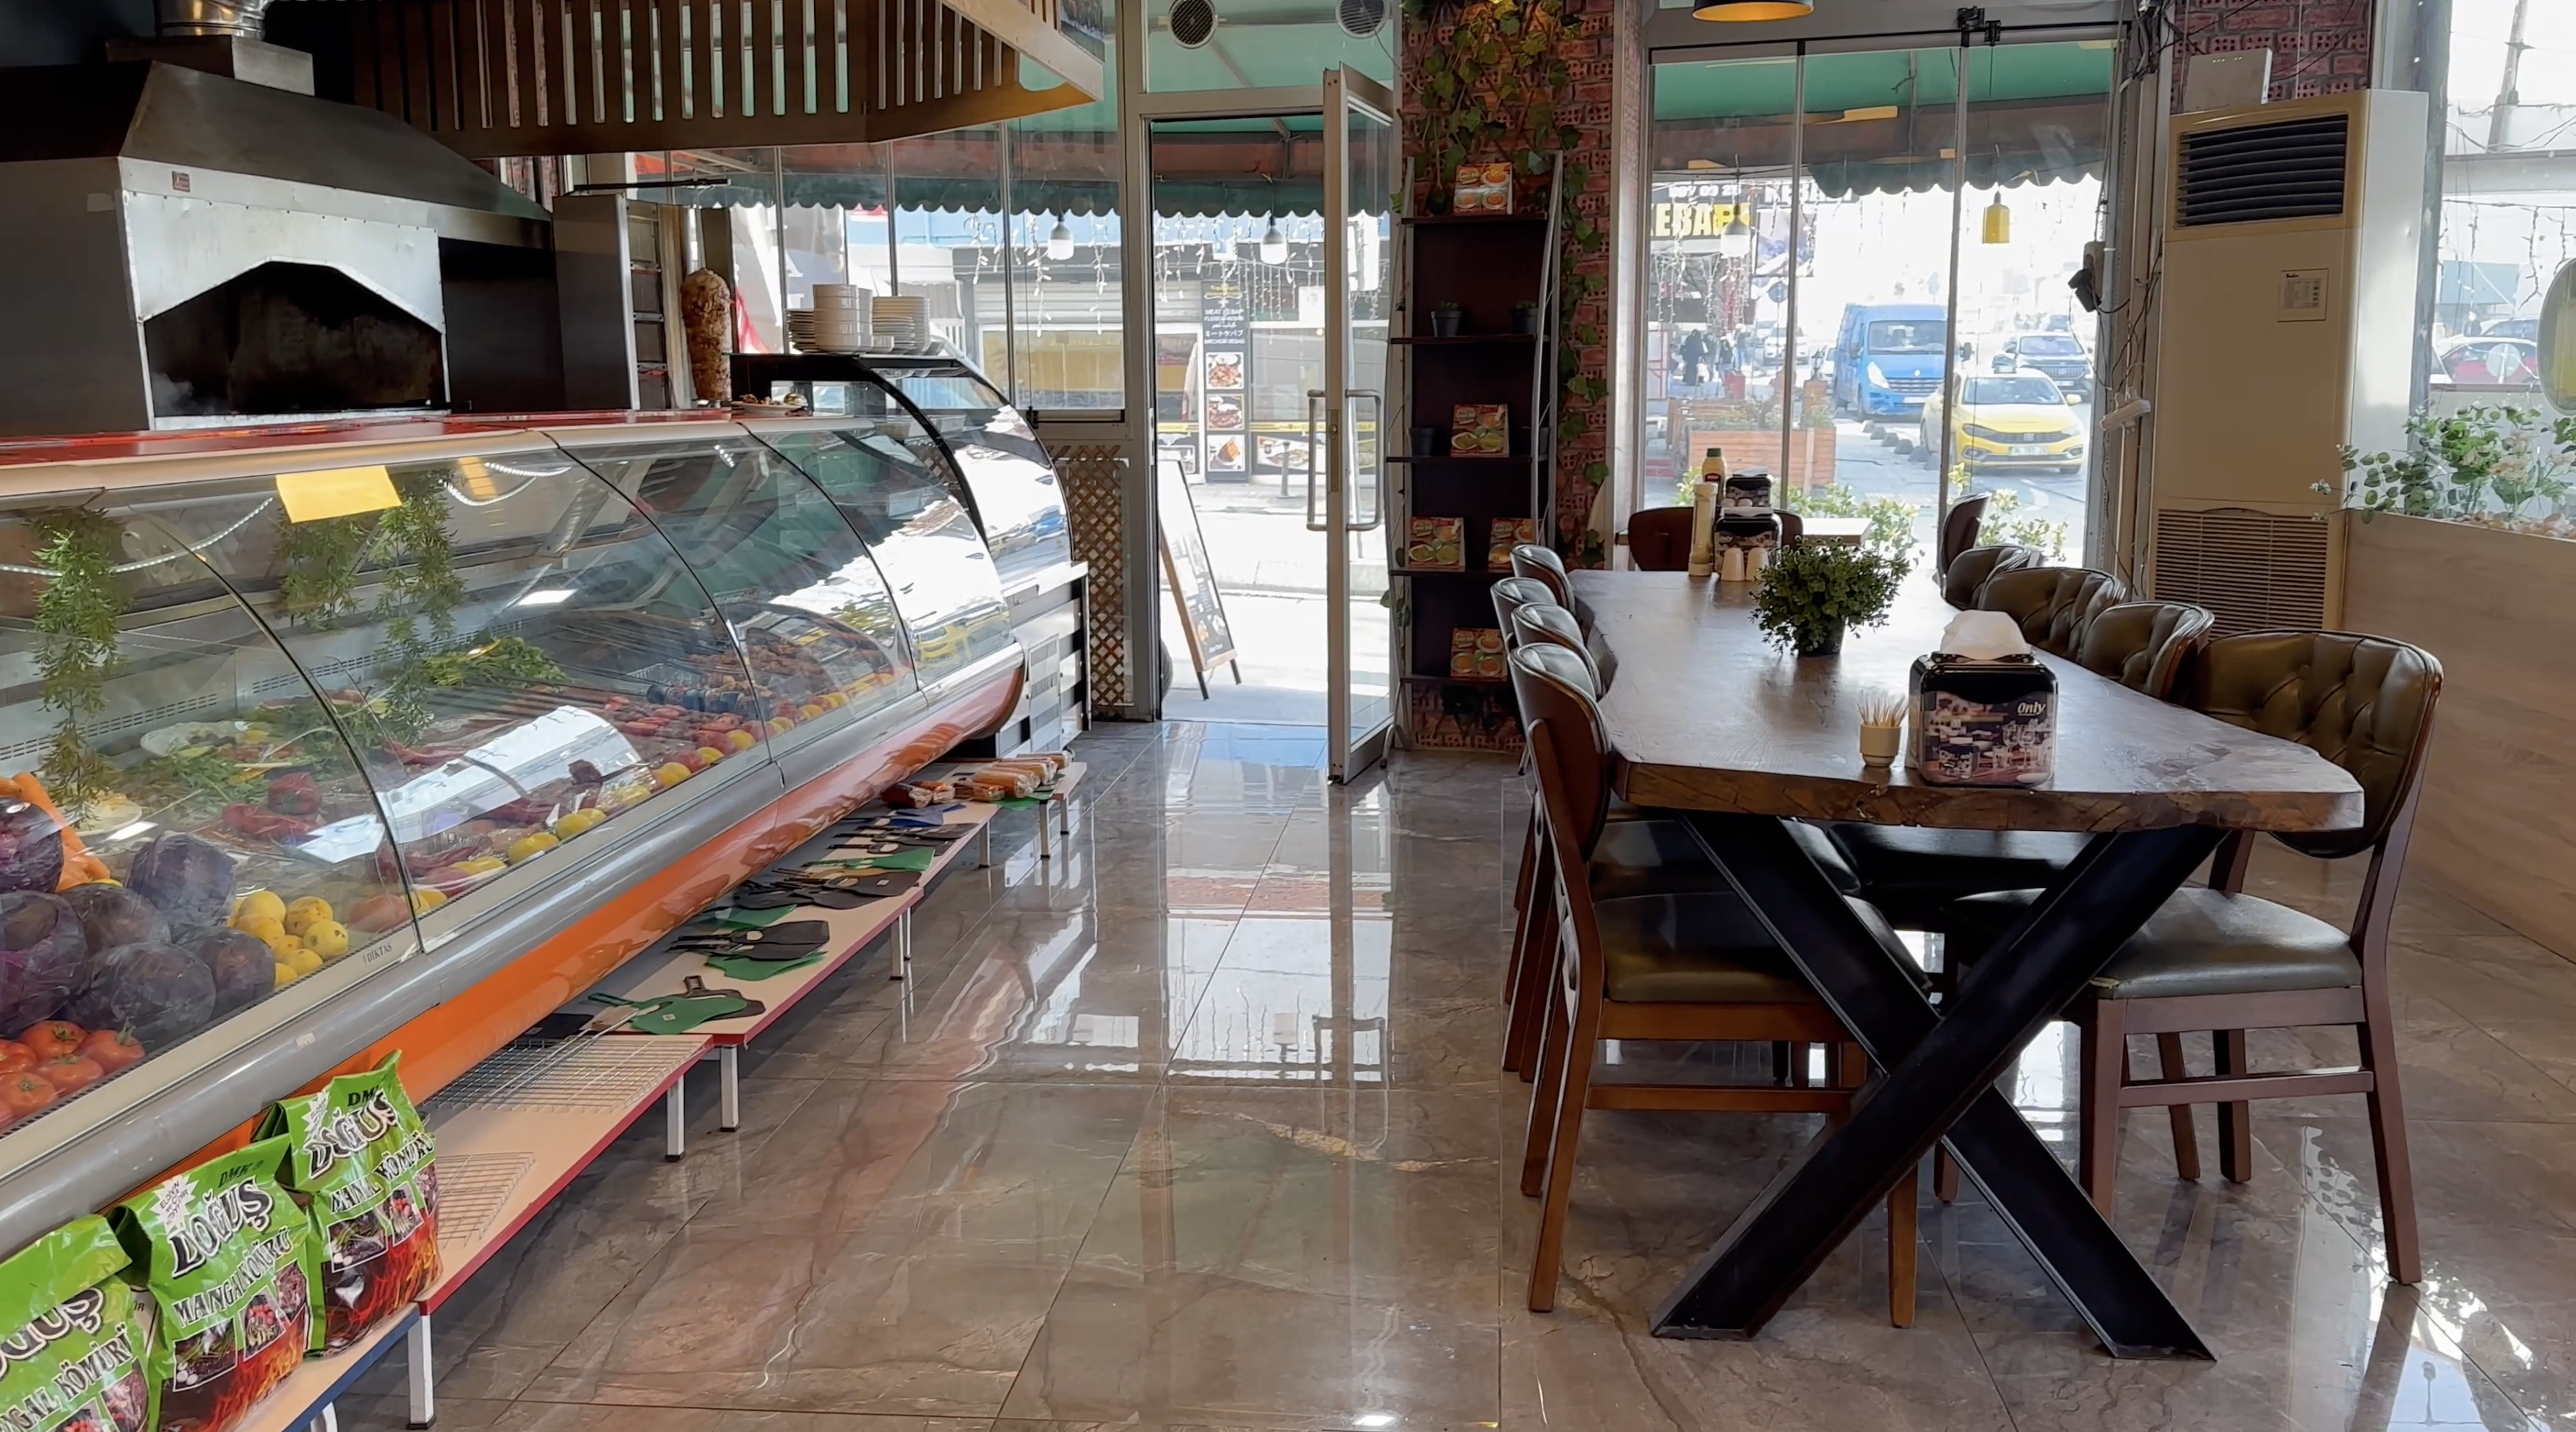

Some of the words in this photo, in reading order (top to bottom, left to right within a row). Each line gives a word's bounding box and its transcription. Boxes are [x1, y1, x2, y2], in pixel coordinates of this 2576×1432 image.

[2017, 702, 2046, 716] Only
[218, 1163, 254, 1188] DMK
[167, 1175, 274, 1279] DOĞUŞ
